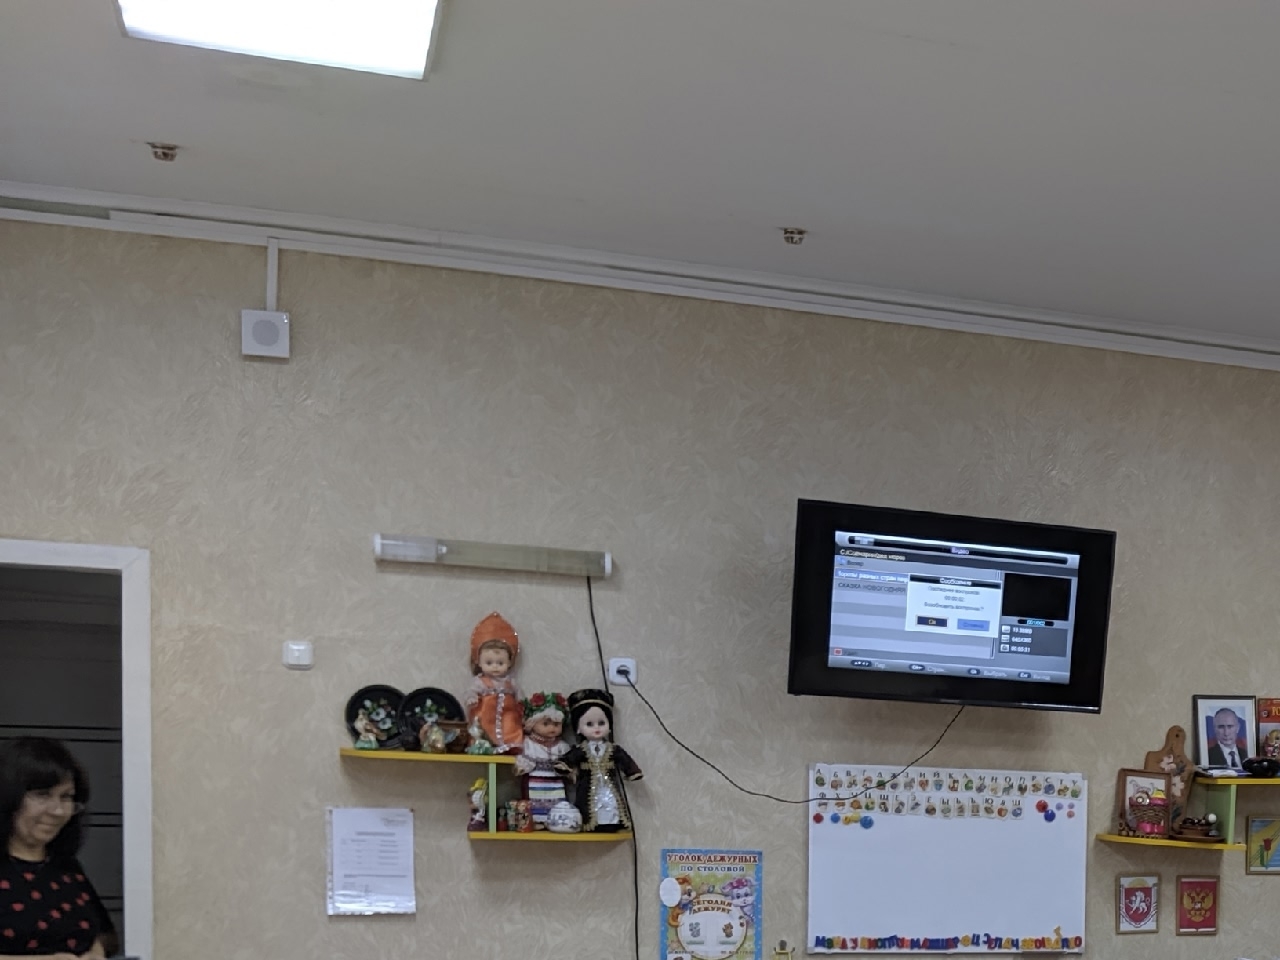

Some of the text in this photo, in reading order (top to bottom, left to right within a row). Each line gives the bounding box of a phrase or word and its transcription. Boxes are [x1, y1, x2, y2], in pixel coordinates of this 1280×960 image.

[667, 853, 758, 864] УГОЛОК ДЕЖУРНЫХ
[691, 899, 733, 908] СЕГОДНЯ
